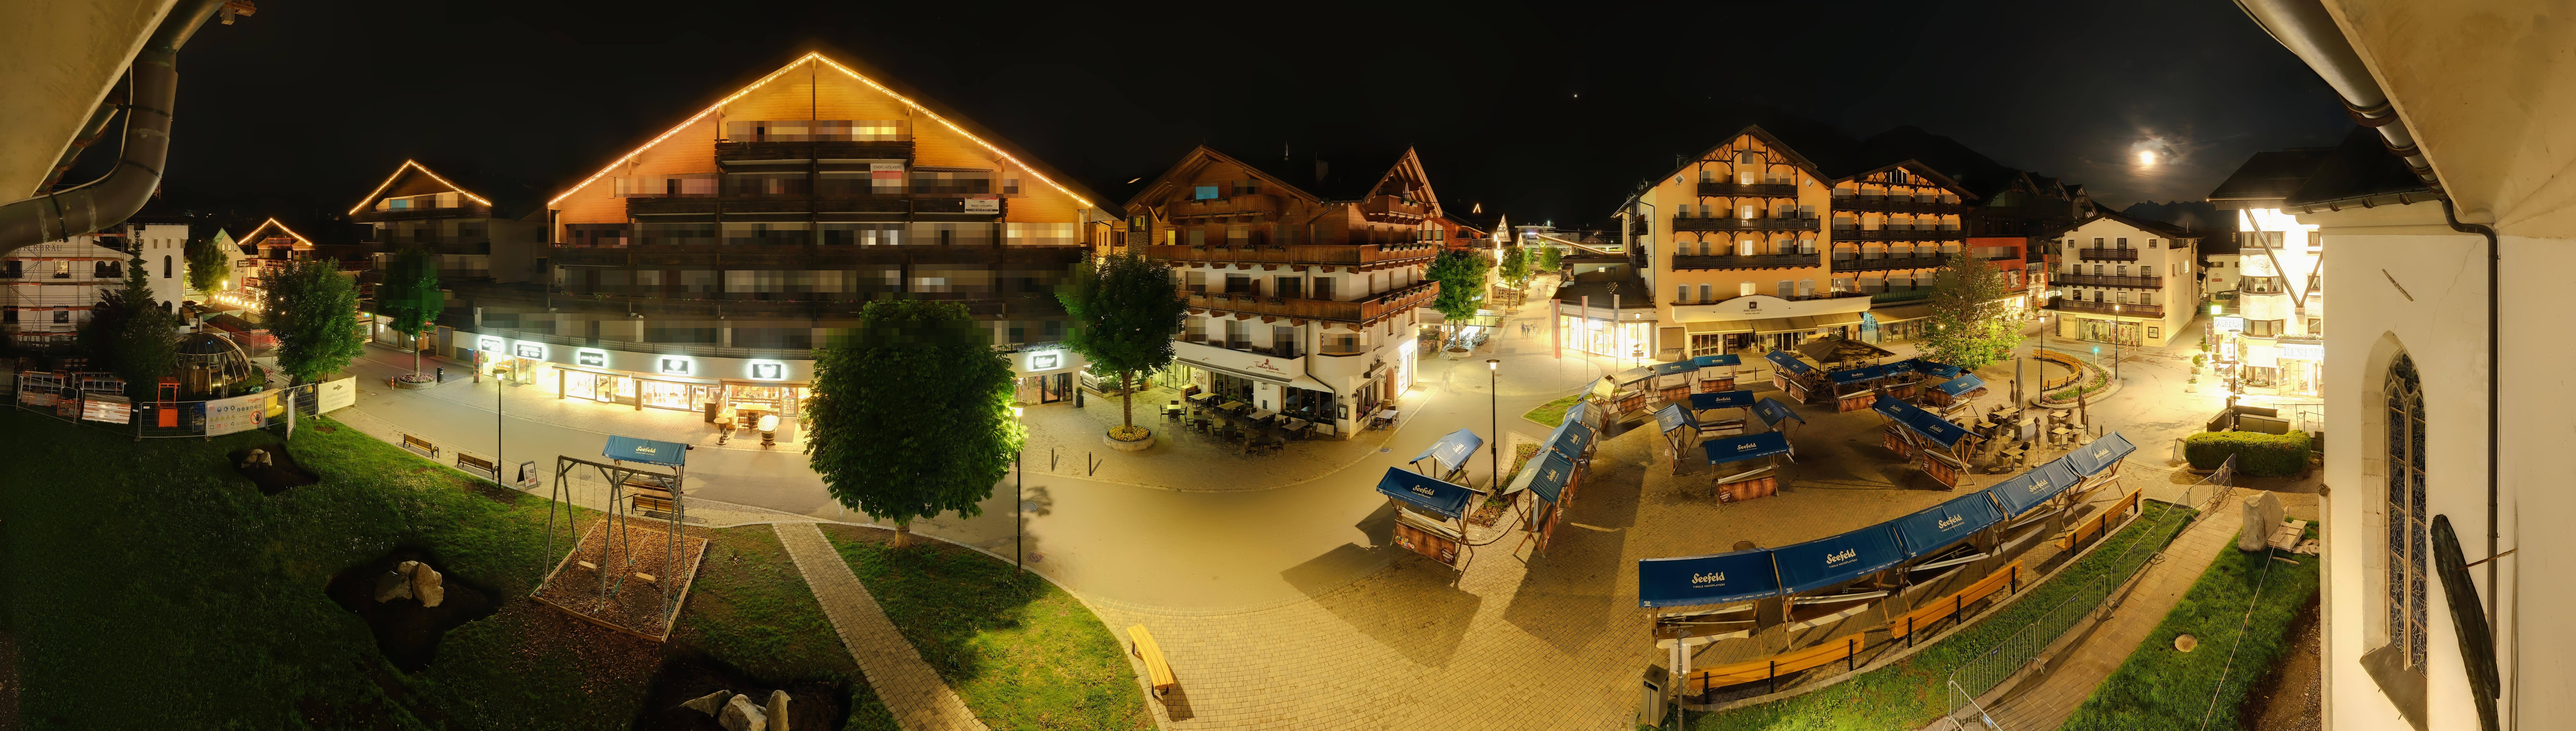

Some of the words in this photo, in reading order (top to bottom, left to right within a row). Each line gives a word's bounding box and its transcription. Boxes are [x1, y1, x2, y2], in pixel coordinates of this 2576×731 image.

[1371, 364, 1386, 377] RESTAURANT
[326, 395, 349, 403] KONGRESSZENTRUM
[1570, 434, 1579, 444] Seefeld
[1453, 443, 1464, 453] Seefeld
[2094, 448, 2109, 459] Seefeld
[1547, 469, 1556, 481] Seefeld
[1413, 484, 1435, 496] Seefeld
[2029, 479, 2048, 492] Seefeld
[1938, 514, 1962, 529] Seefeld
[1826, 548, 1856, 564] Seefeld
[1692, 571, 1725, 584] Seefeld
